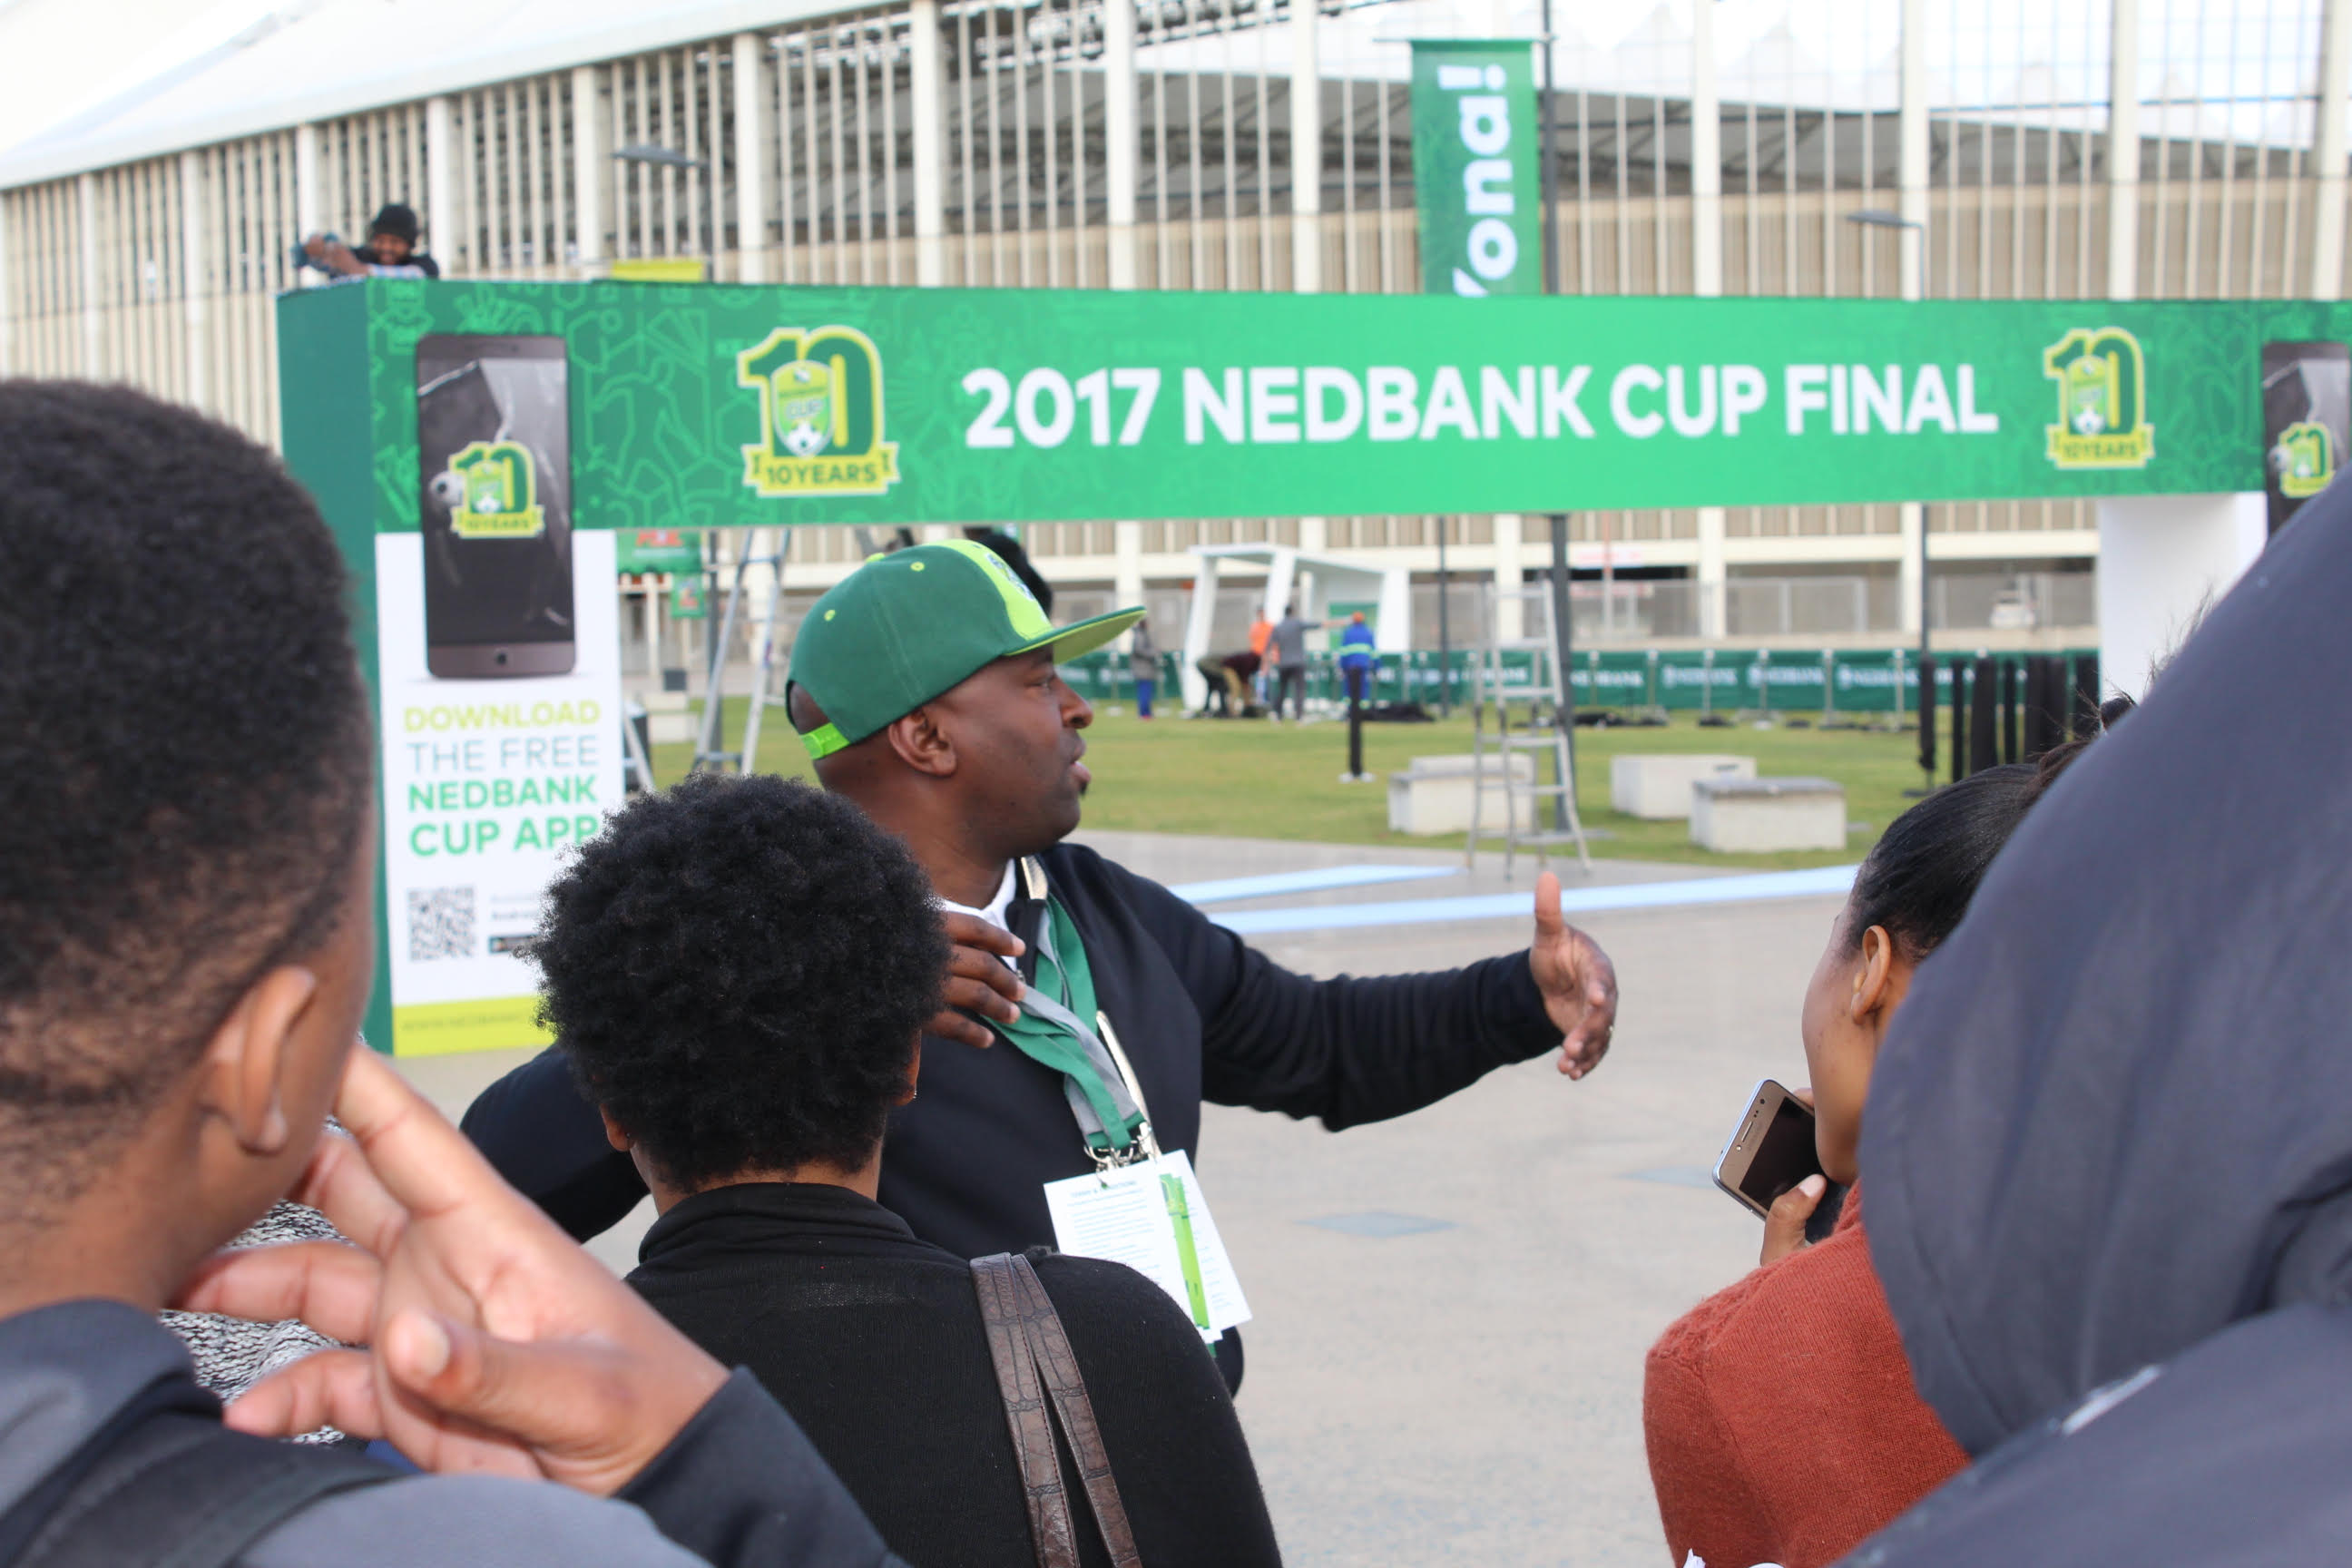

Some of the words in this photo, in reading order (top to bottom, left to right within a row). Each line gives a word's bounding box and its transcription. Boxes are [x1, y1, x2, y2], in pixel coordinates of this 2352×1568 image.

[962, 367, 1161, 448] 2017
[1182, 365, 1595, 444] NEDBANK
[1610, 364, 1769, 438] CUP
[1785, 363, 1999, 435] FINAL
[404, 700, 602, 733] DOWNLOAD
[406, 739, 485, 773] THE
[500, 734, 599, 769] FREE
[407, 774, 598, 812] NEDBANK
[409, 819, 500, 858] CUP
[513, 815, 599, 852] APP
